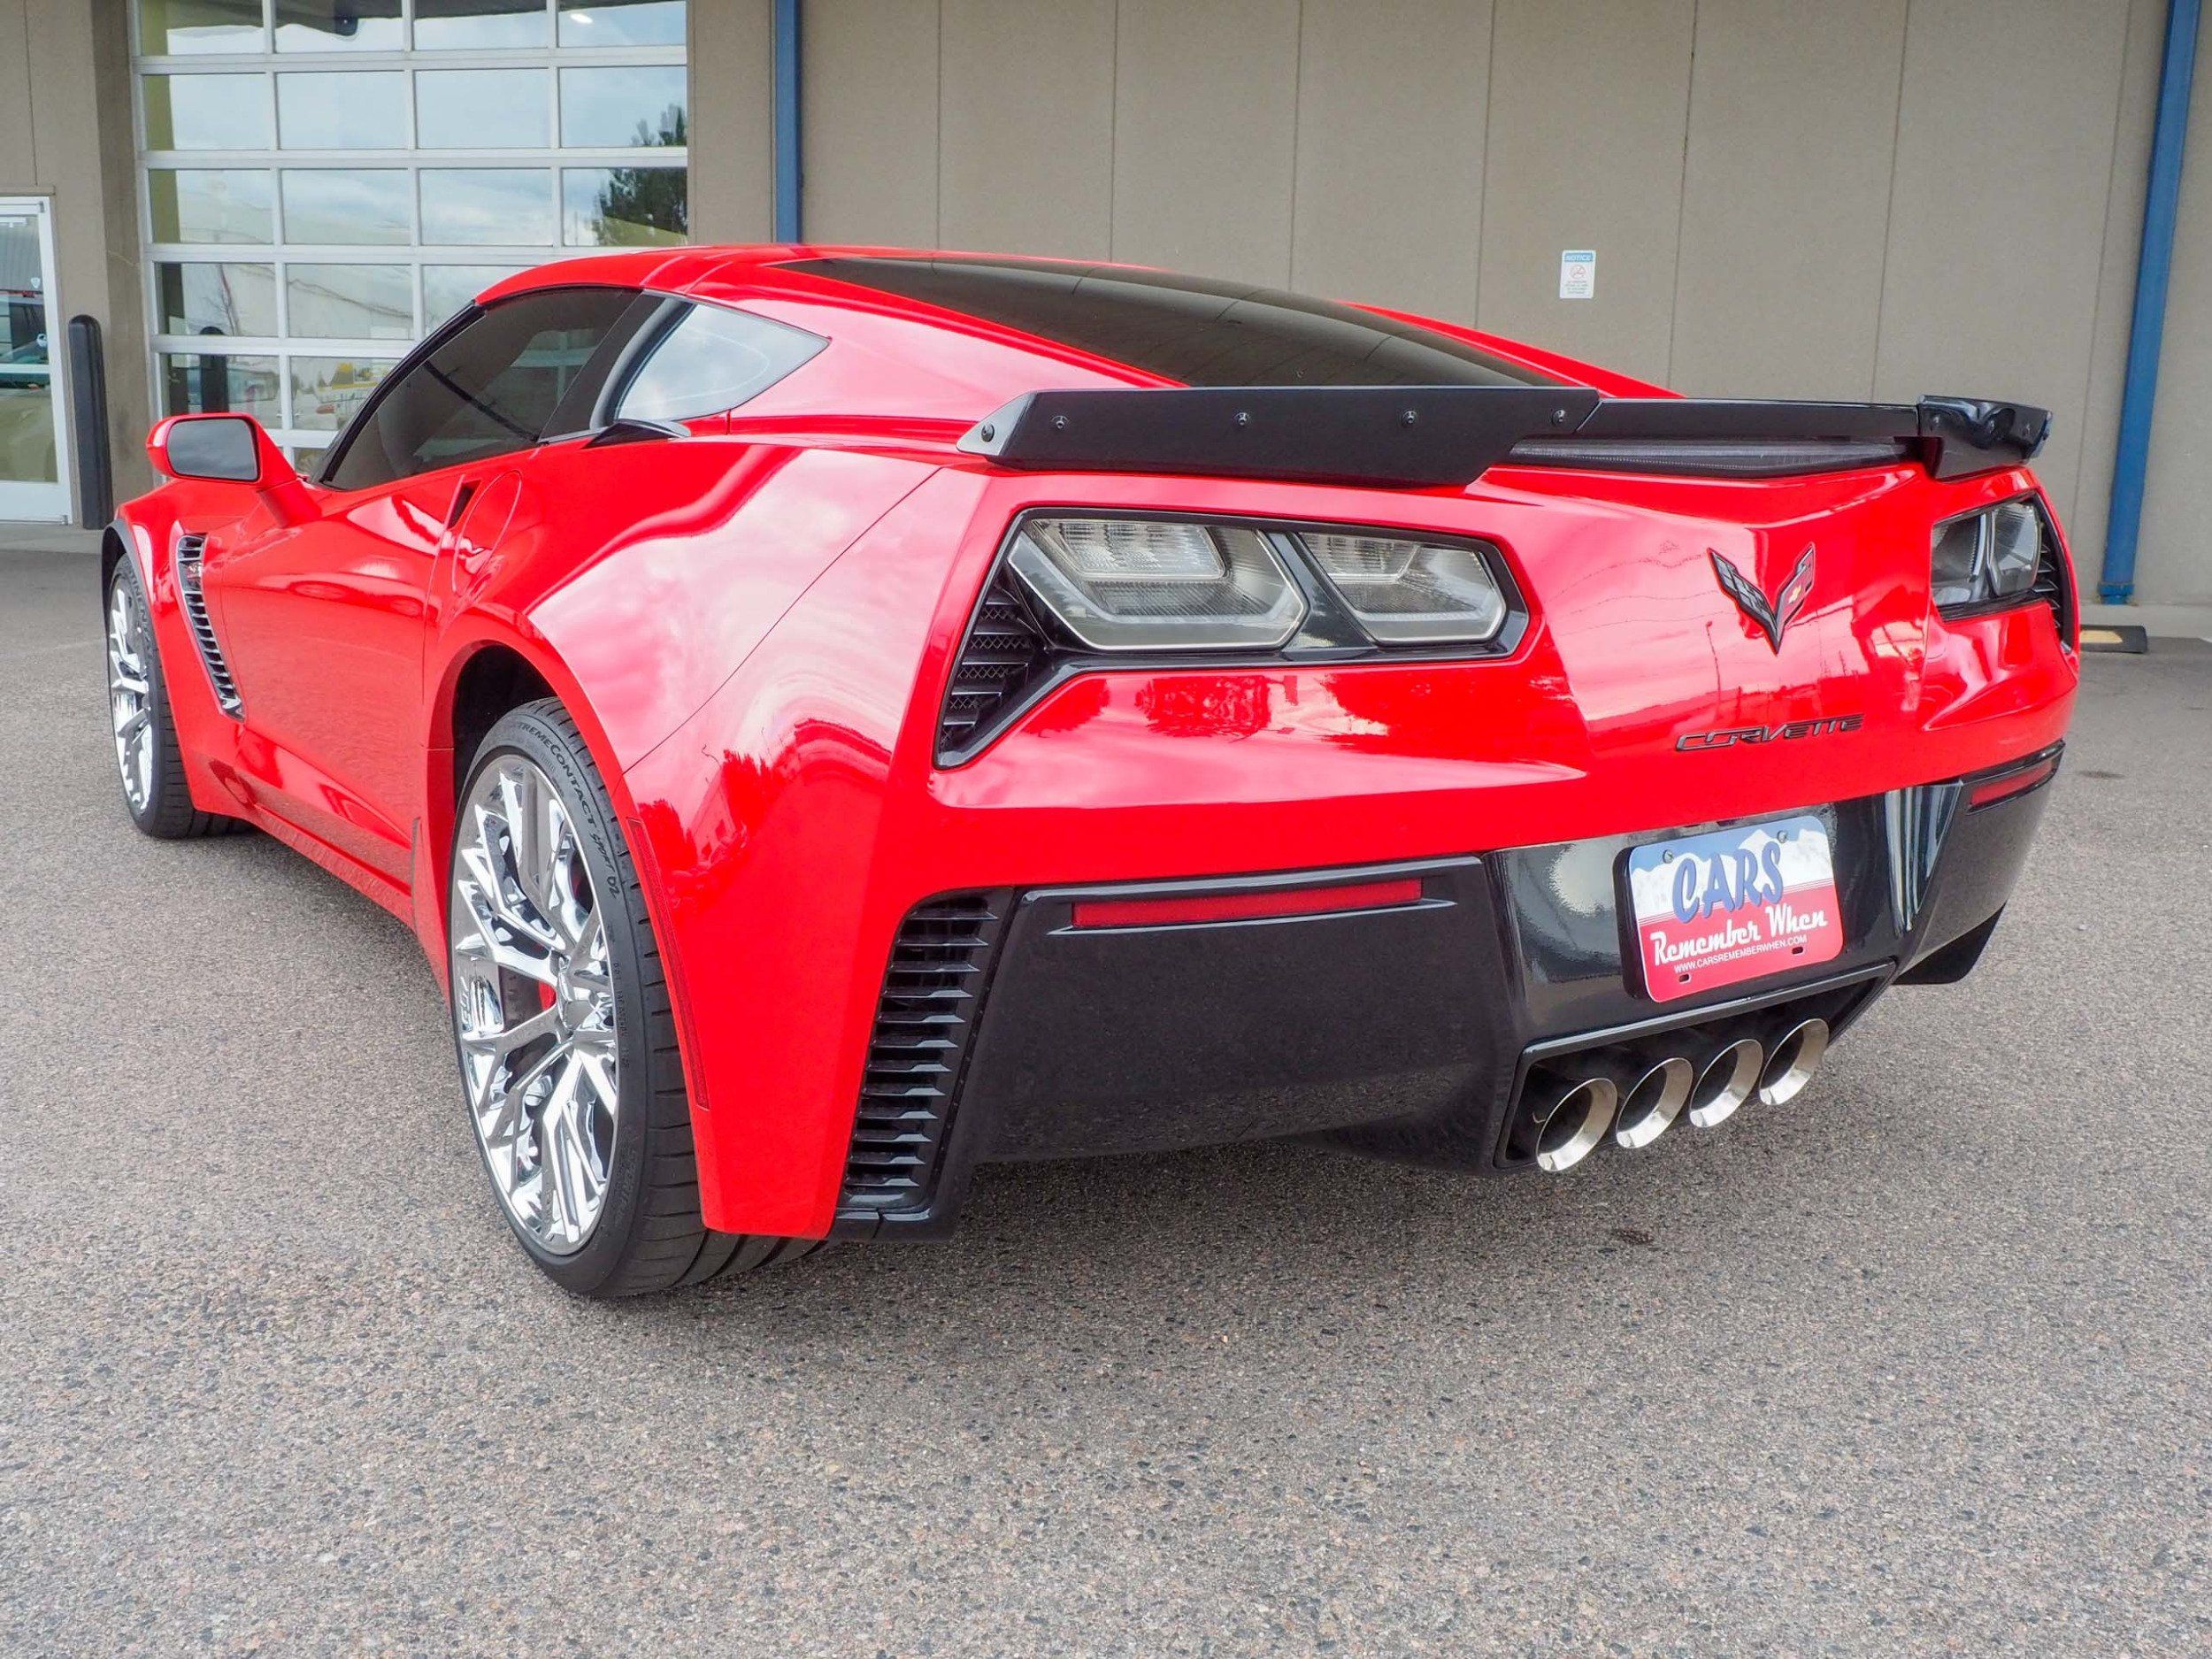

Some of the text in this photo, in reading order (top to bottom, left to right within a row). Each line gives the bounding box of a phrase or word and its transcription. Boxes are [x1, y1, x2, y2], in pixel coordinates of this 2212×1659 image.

[1676, 713, 1863, 751] CORVETTE
[1672, 841, 1783, 924] CARS
[1650, 902, 1829, 966] Remember When
[1673, 934, 1809, 974] WWW.CARSREMEMBERWHEN.COM
